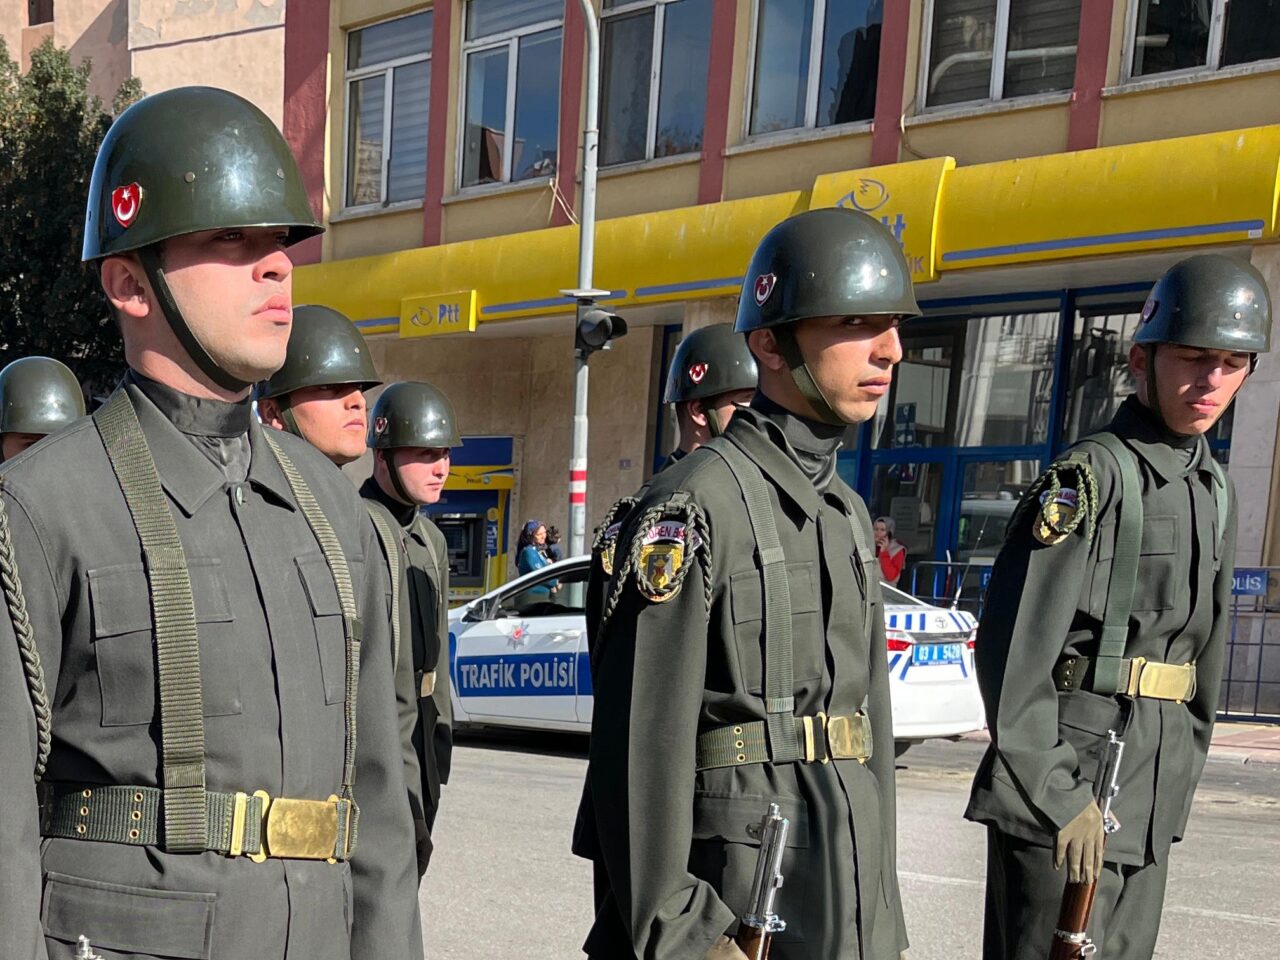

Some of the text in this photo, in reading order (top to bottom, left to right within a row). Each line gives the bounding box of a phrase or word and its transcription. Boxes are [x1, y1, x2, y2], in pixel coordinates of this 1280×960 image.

[438, 303, 459, 325] Ptt
[460, 656, 575, 689] TRAFİK POLİSİ
